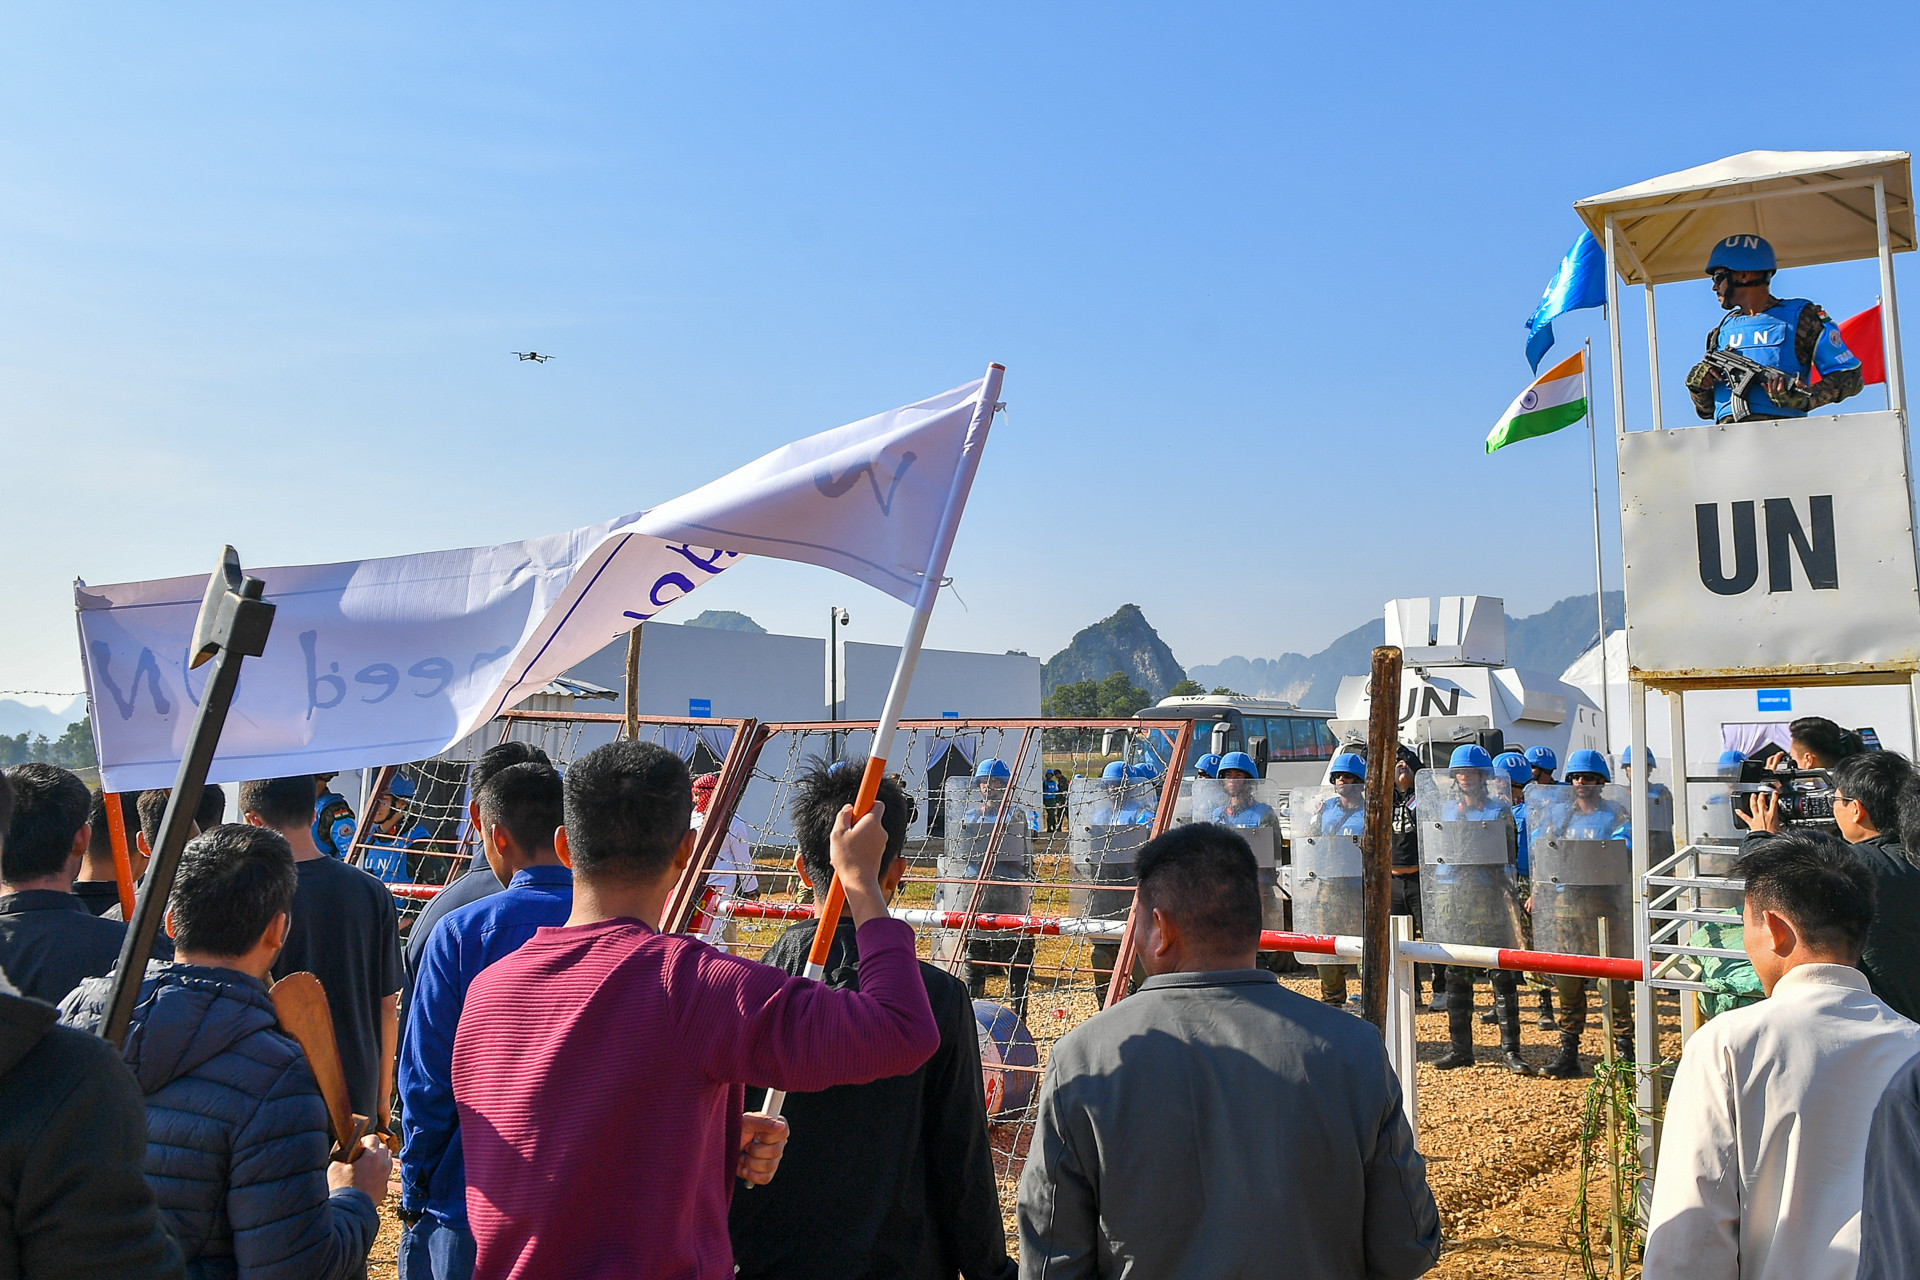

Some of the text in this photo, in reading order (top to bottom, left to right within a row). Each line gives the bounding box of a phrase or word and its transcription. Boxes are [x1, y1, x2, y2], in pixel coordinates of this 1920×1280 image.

[1725, 235, 1759, 250] UN
[1729, 330, 1769, 348] UN
[1694, 494, 1839, 597] UN
[1535, 748, 1553, 758] UN
[1506, 756, 1527, 768] UN
[364, 858, 387, 869] UN
